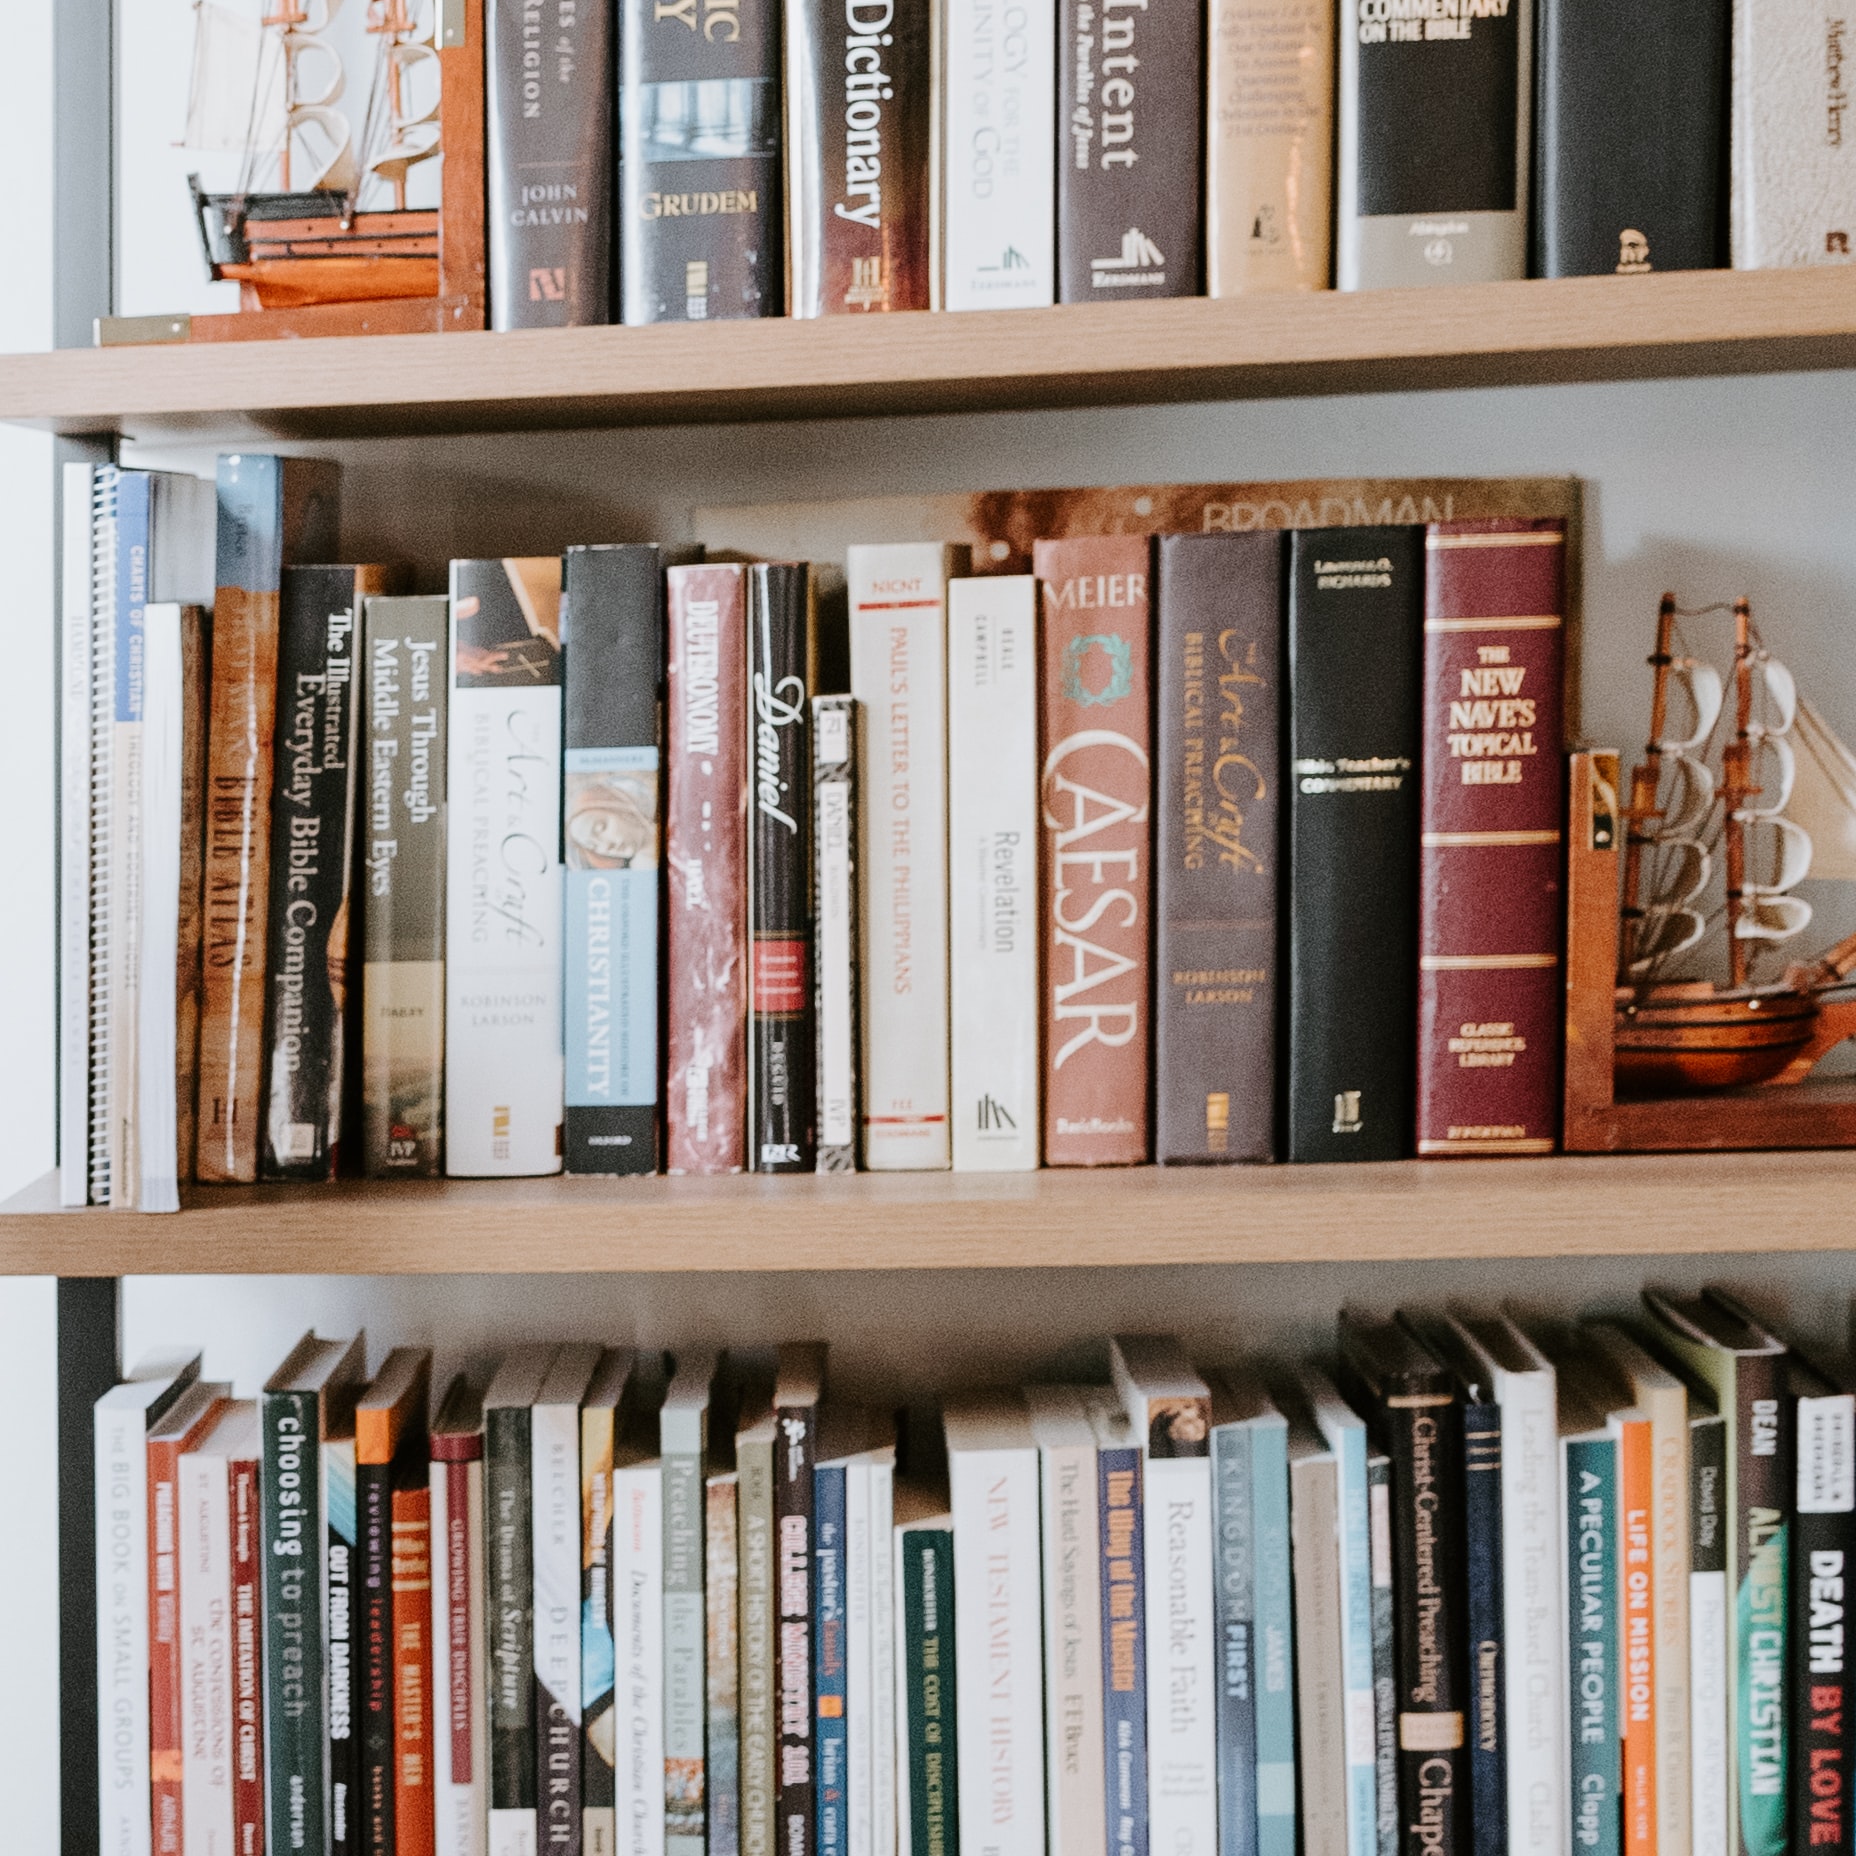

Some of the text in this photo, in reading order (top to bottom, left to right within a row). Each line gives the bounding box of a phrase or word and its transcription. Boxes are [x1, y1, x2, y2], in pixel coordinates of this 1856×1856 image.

[557, 37, 574, 55] of
[1075, 4, 1093, 31] the
[1359, 17, 1471, 44] ON THE BIBLE
[558, 56, 574, 82] the
[1073, 35, 1095, 103] Parables
[1071, 128, 1092, 171] Jesus
[1072, 105, 1093, 124] of
[521, 186, 578, 200] JOHN
[971, 126, 1000, 199] GOD
[512, 211, 588, 225] CALVIN
[638, 191, 757, 219] GRUDEM
[1042, 573, 1146, 608] MEIER
[688, 599, 719, 756] DEUTERONOMY
[974, 614, 989, 687] CAMPBELL
[1001, 626, 1016, 671] BEALE
[1460, 665, 1526, 698] NEW
[322, 608, 352, 770] The Illustrated
[1448, 699, 1538, 730] NAVE'S
[402, 636, 438, 823] Jesus Through
[754, 675, 806, 834] Daniel
[1181, 632, 1204, 870] BIBLICAL PREACHING
[1448, 732, 1538, 757] TOPICAL
[367, 638, 396, 896] Middle Eastern Eyes
[1460, 761, 1523, 784] BIBLE
[889, 626, 913, 995] PAUL'S LETTER TO THE PHILIPPIANS
[280, 672, 325, 1074] Everyday Bible Companion
[991, 830, 1020, 955] Revelation
[1039, 729, 1149, 1070] CAESAR
[584, 877, 612, 1098] CHRISTIANITY
[1751, 1399, 1778, 1455] DEAN
[269, 1416, 308, 1718] choosing to preach
[1411, 1416, 1443, 1702] Christ-Centered Preaching
[327, 1544, 352, 1740] OUT FROM DARKNESS
[450, 1607, 468, 1645] TRUE
[1165, 1500, 1196, 1735] Reasonable Faith
[1578, 1470, 1605, 1745] A PECULIAR PEOPLE
[1627, 1508, 1650, 1721] LIFE ON MISSION
[496, 1607, 521, 1710] Scripture
[1748, 1506, 1782, 1795] ALMOST CHRISTIAN
[1808, 1550, 1843, 1846] DEATH BY LOVE
[548, 1701, 572, 1844] CHURCH
[1577, 1773, 1605, 1845] Clapp
[287, 1774, 307, 1848] anderson
